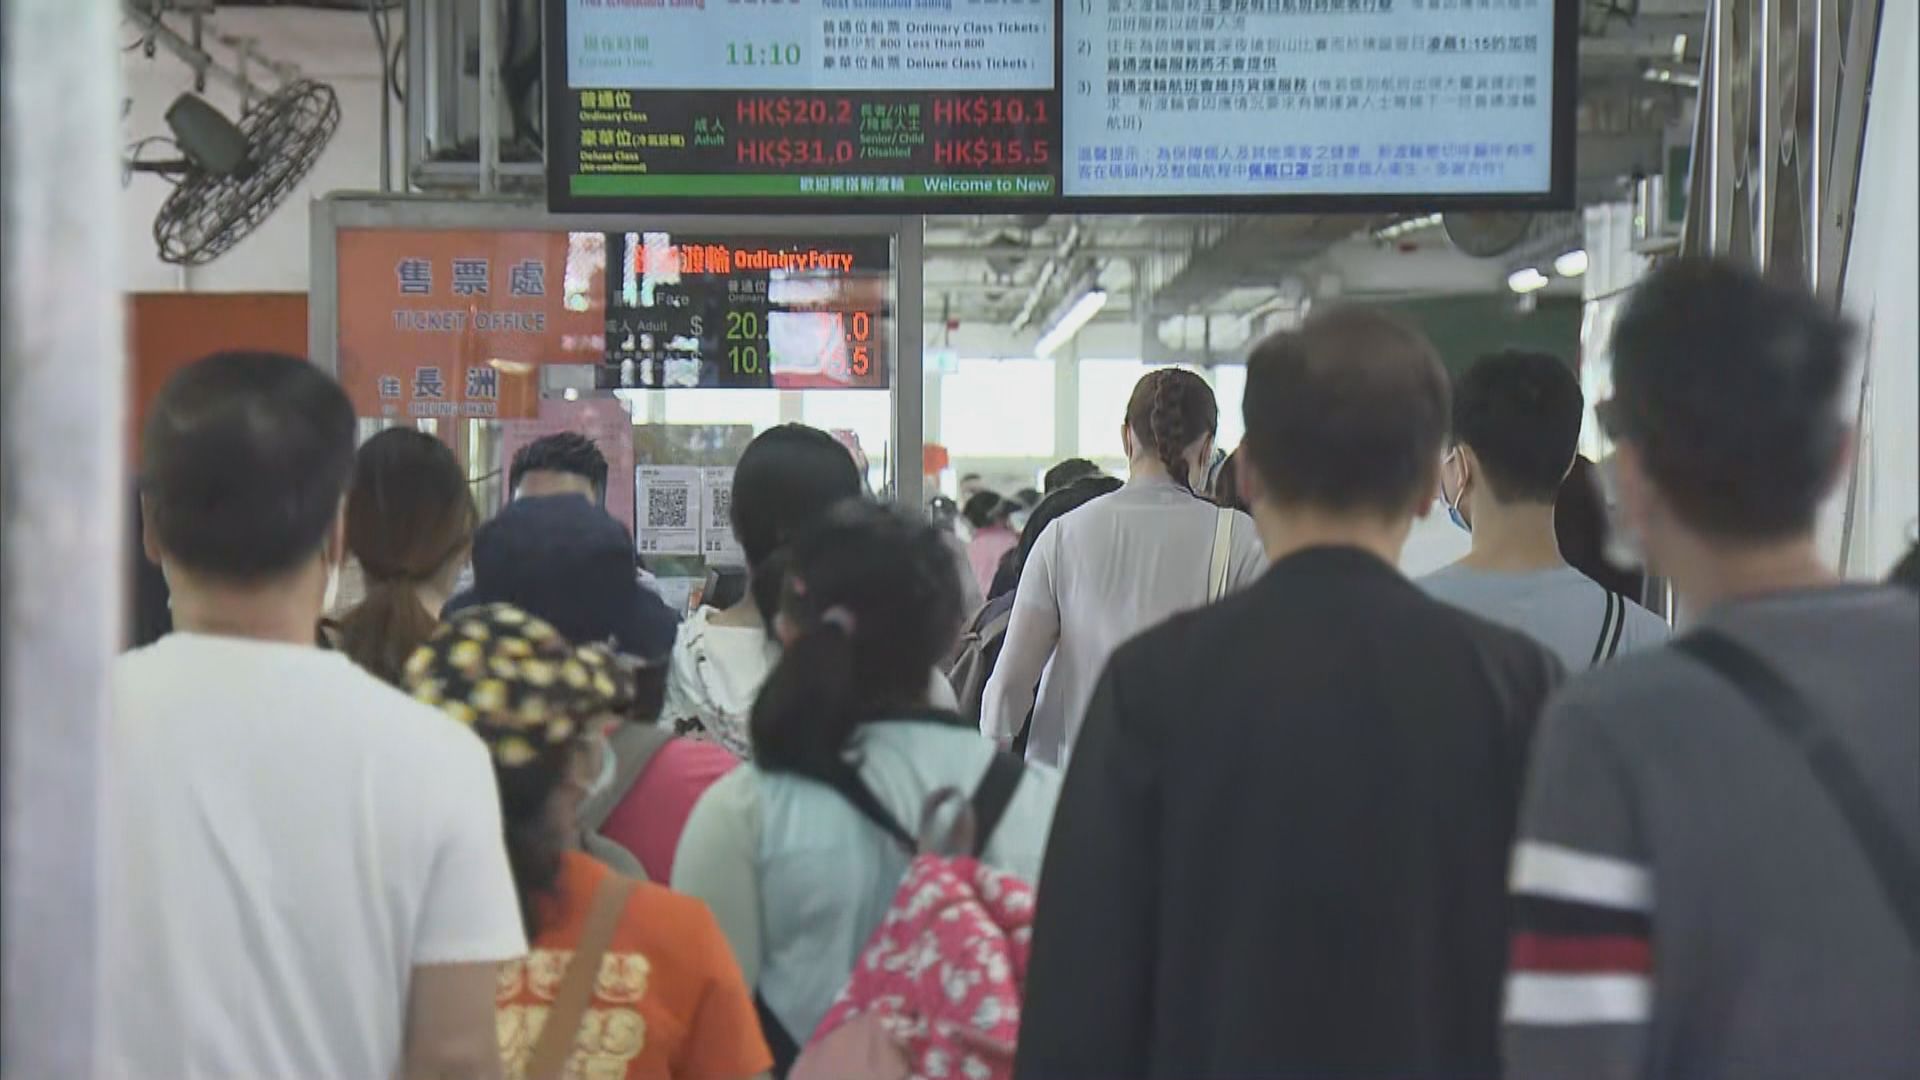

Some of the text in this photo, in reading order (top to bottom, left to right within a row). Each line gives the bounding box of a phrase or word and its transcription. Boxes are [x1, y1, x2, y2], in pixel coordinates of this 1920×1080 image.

[907, 22, 958, 35] Ordinary
[964, 22, 993, 34] Class
[999, 22, 1039, 34] Tickets
[907, 39, 930, 48] Less
[934, 39, 960, 48] Than
[727, 43, 801, 65] 11:10
[907, 57, 947, 69] Deluxe
[952, 57, 982, 69] Class
[986, 57, 1027, 69] Tickets
[580, 111, 648, 123] Ordinary Class
[737, 99, 852, 127] HK$20.2
[934, 99, 1048, 127] HK$10.1
[694, 134, 725, 146] Adult
[899, 132, 925, 144] Child
[737, 139, 853, 167] HK$31.0
[934, 139, 1049, 167] HK$15.5
[924, 177, 992, 192] Welcome
[996, 179, 1012, 192] to
[1015, 178, 1051, 192] New
[735, 249, 808, 273] Ordinary
[810, 250, 853, 273] Ferry
[396, 259, 545, 296] 售票處
[393, 311, 545, 331] TICKET OFFICE
[637, 319, 668, 332] Adult
[727, 311, 769, 341] 20.
